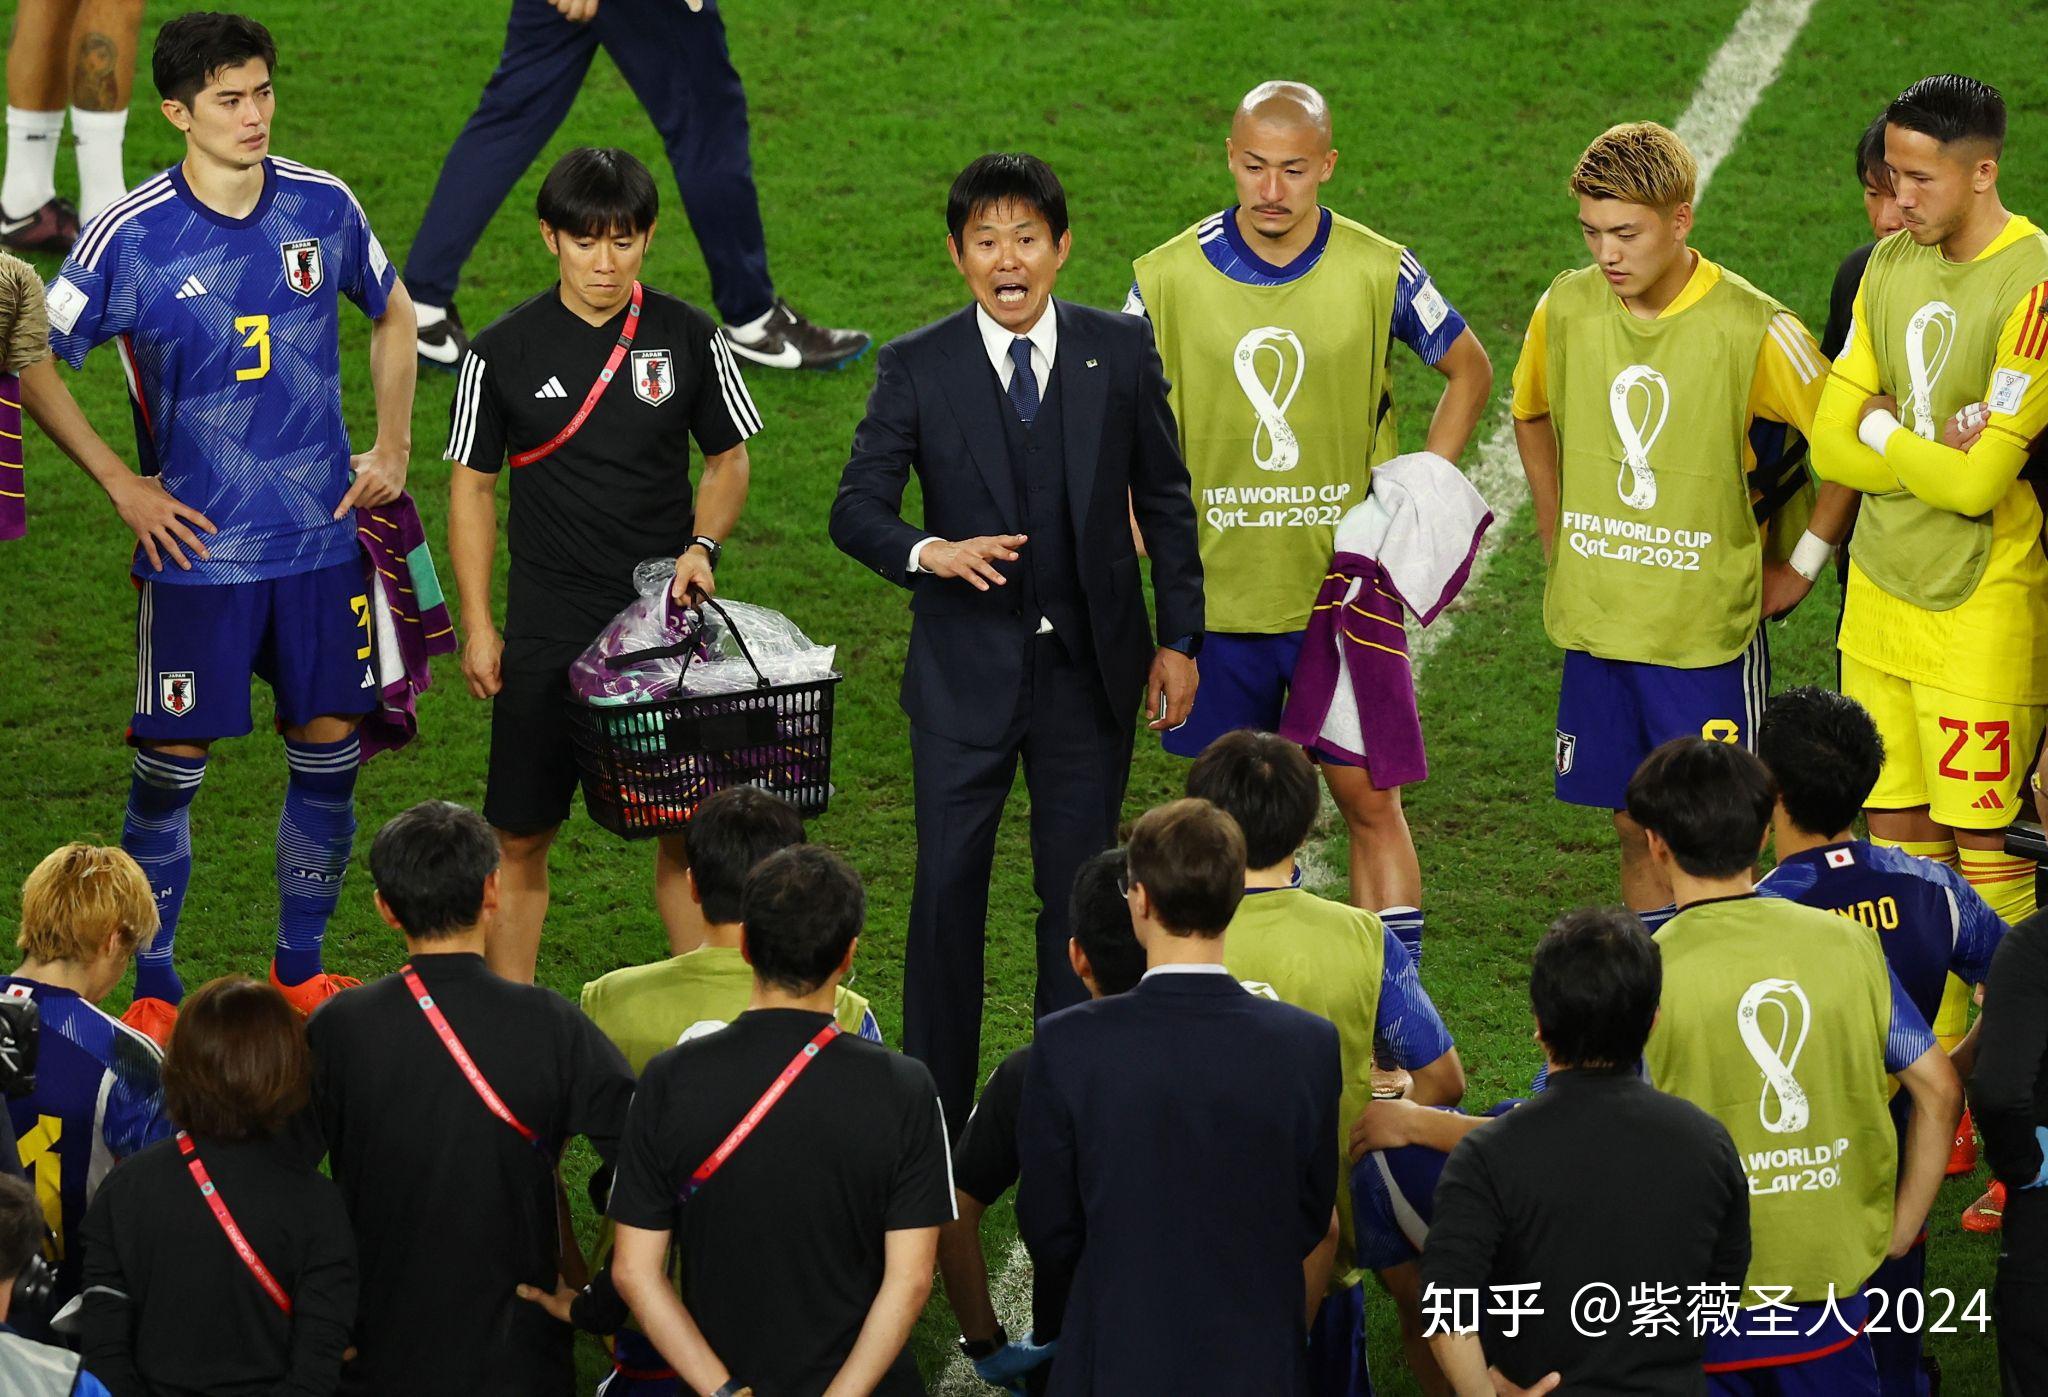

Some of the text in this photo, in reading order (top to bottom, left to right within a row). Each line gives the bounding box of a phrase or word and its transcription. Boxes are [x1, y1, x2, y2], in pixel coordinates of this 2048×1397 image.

[291, 241, 312, 249] JAPAN
[235, 314, 271, 381] 3
[1239, 485, 1316, 504] WORLD
[1318, 483, 1351, 503] CUP
[1562, 511, 1712, 549] FIFA WORLD CUP
[1569, 532, 1700, 571] Qatar2022
[350, 593, 372, 660] 3
[1938, 716, 2010, 781] 23
[292, 869, 347, 882] JAP
[1829, 896, 1899, 930] DO
[1747, 1145, 1832, 1171] WORLD
